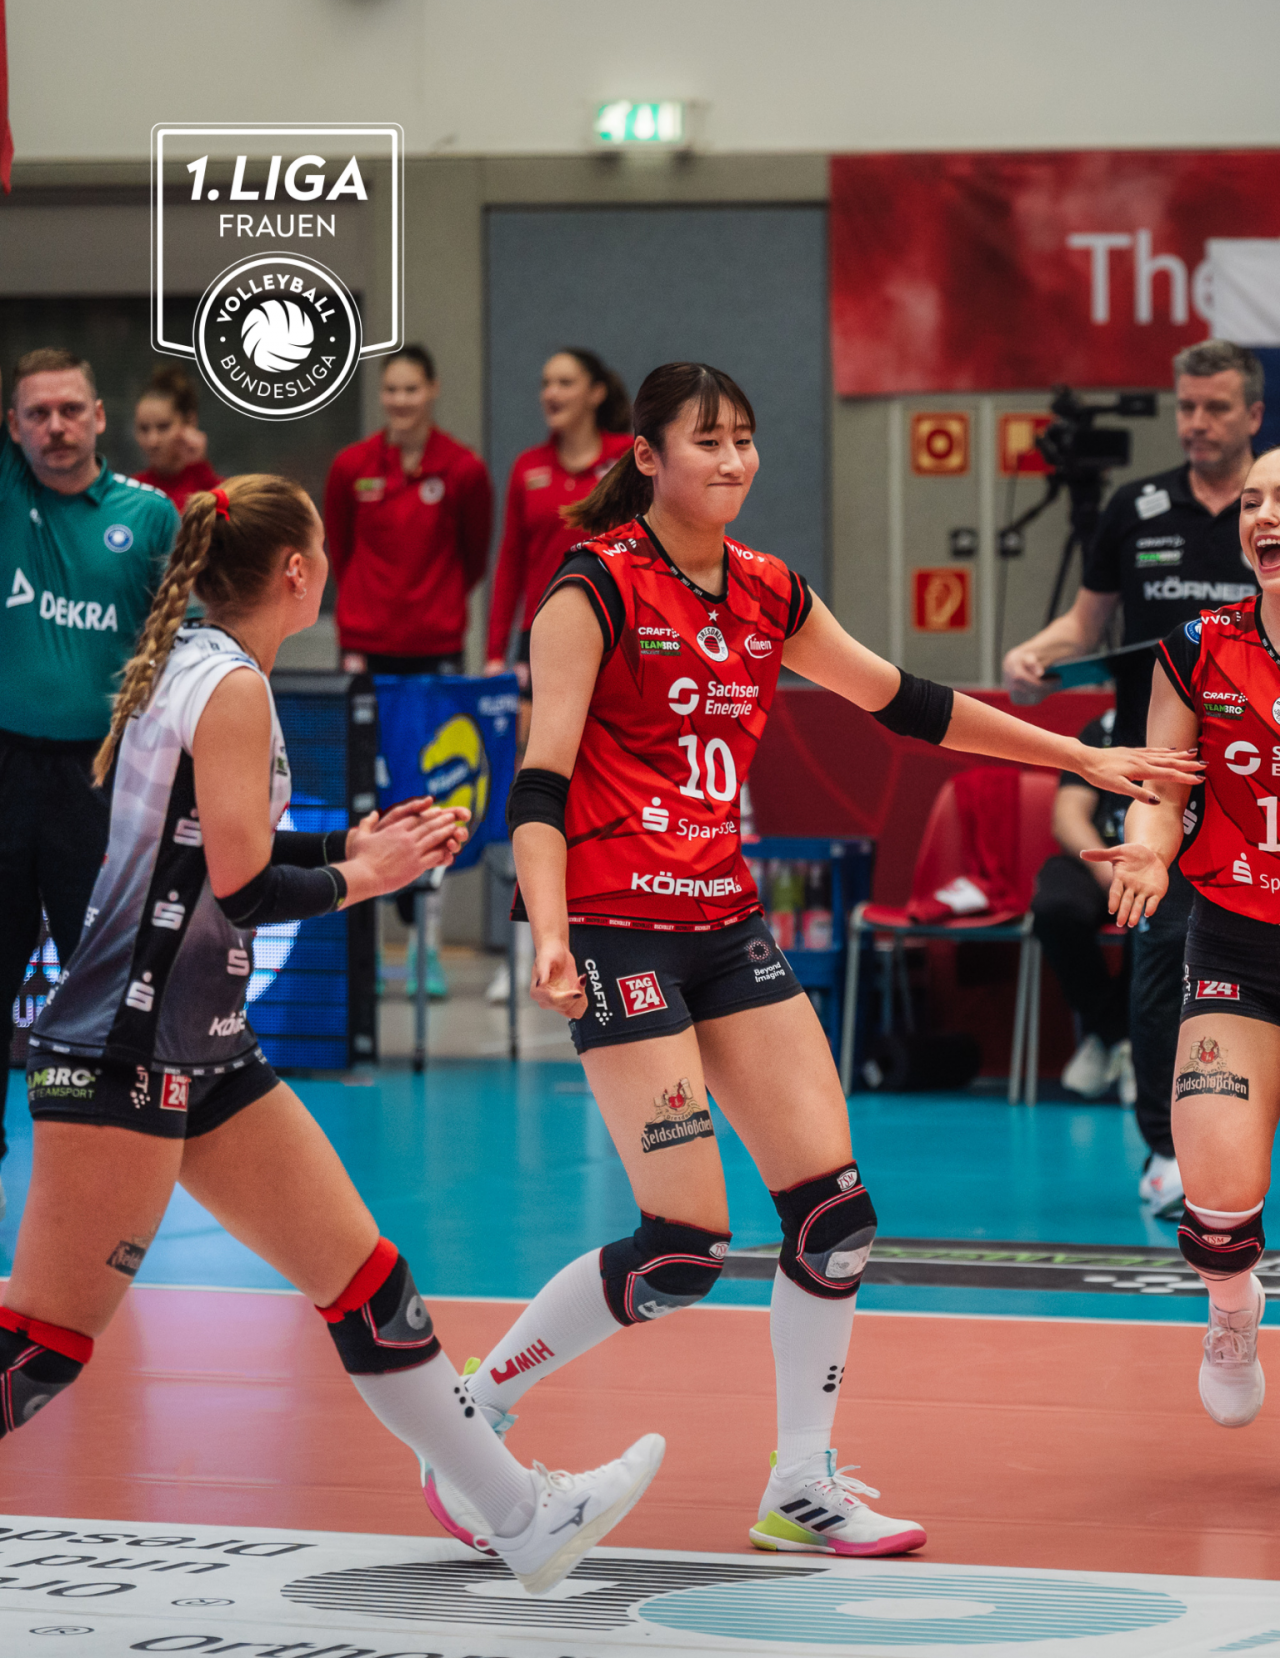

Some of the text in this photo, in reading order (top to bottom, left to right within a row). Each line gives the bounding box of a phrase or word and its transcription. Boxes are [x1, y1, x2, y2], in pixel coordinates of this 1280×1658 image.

[40, 591, 118, 632] DEKRA
[638, 627, 672, 637] CRAFT
[640, 640, 680, 651] TEAMBRO
[708, 680, 759, 698] Sachsen
[1203, 691, 1238, 702] CRAFT
[705, 700, 752, 719] Energie
[1204, 703, 1244, 715] TEAMBRO
[678, 734, 737, 802] 10
[631, 871, 735, 897] KÖRNER
[584, 958, 608, 1010] CRAFT
[626, 977, 652, 991] TAG
[630, 988, 661, 1011] 24
[36, 1087, 95, 1099] TEAMSPORT
[168, 1083, 187, 1106] 24
[0, 1526, 318, 1558] Dresd
[4, 1553, 230, 1574] und
